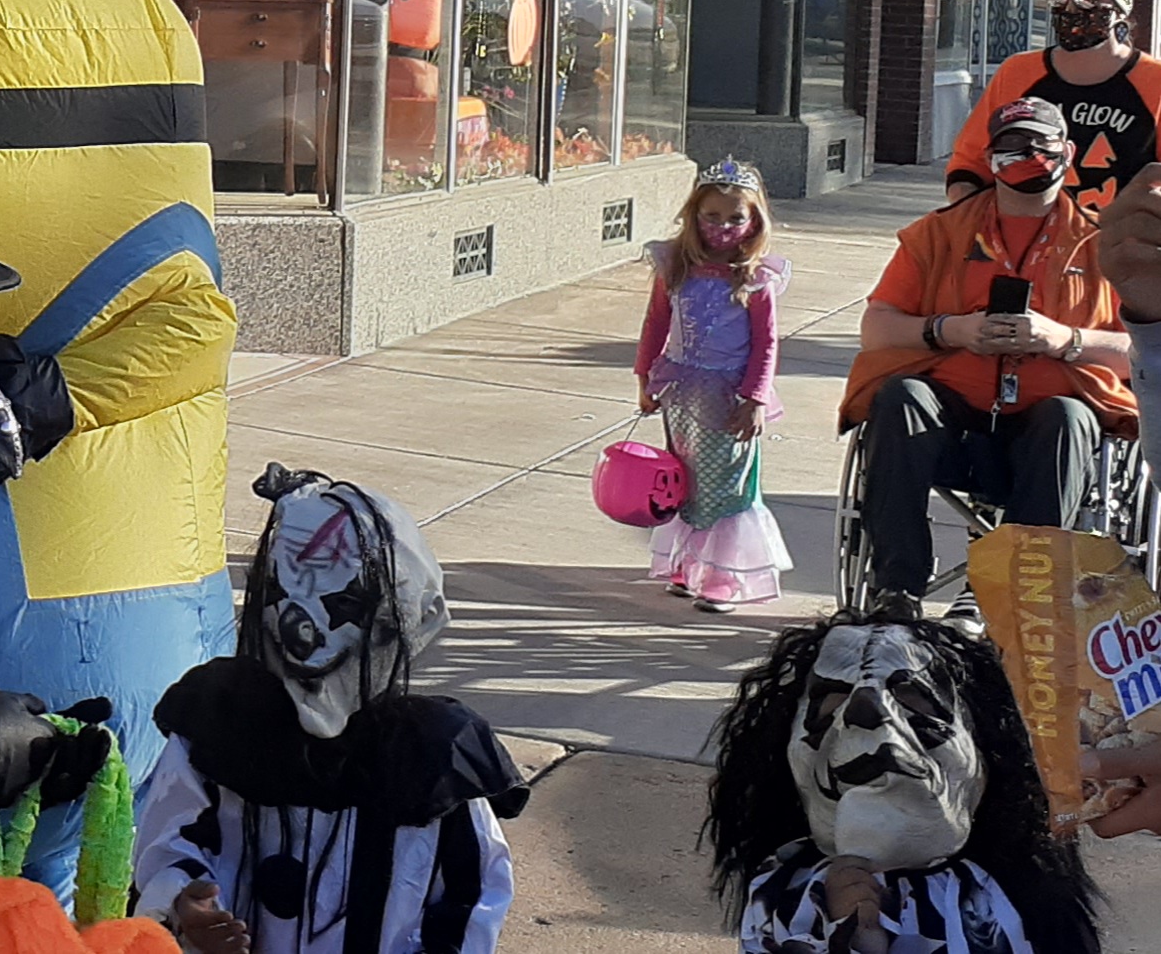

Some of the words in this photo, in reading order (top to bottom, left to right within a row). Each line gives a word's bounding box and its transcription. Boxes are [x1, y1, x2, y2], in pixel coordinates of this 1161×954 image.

[1071, 102, 1136, 133] GLOW
[1017, 532, 1053, 603] NUT
[1019, 608, 1058, 738] HONEY
[1091, 613, 1161, 675] Che
